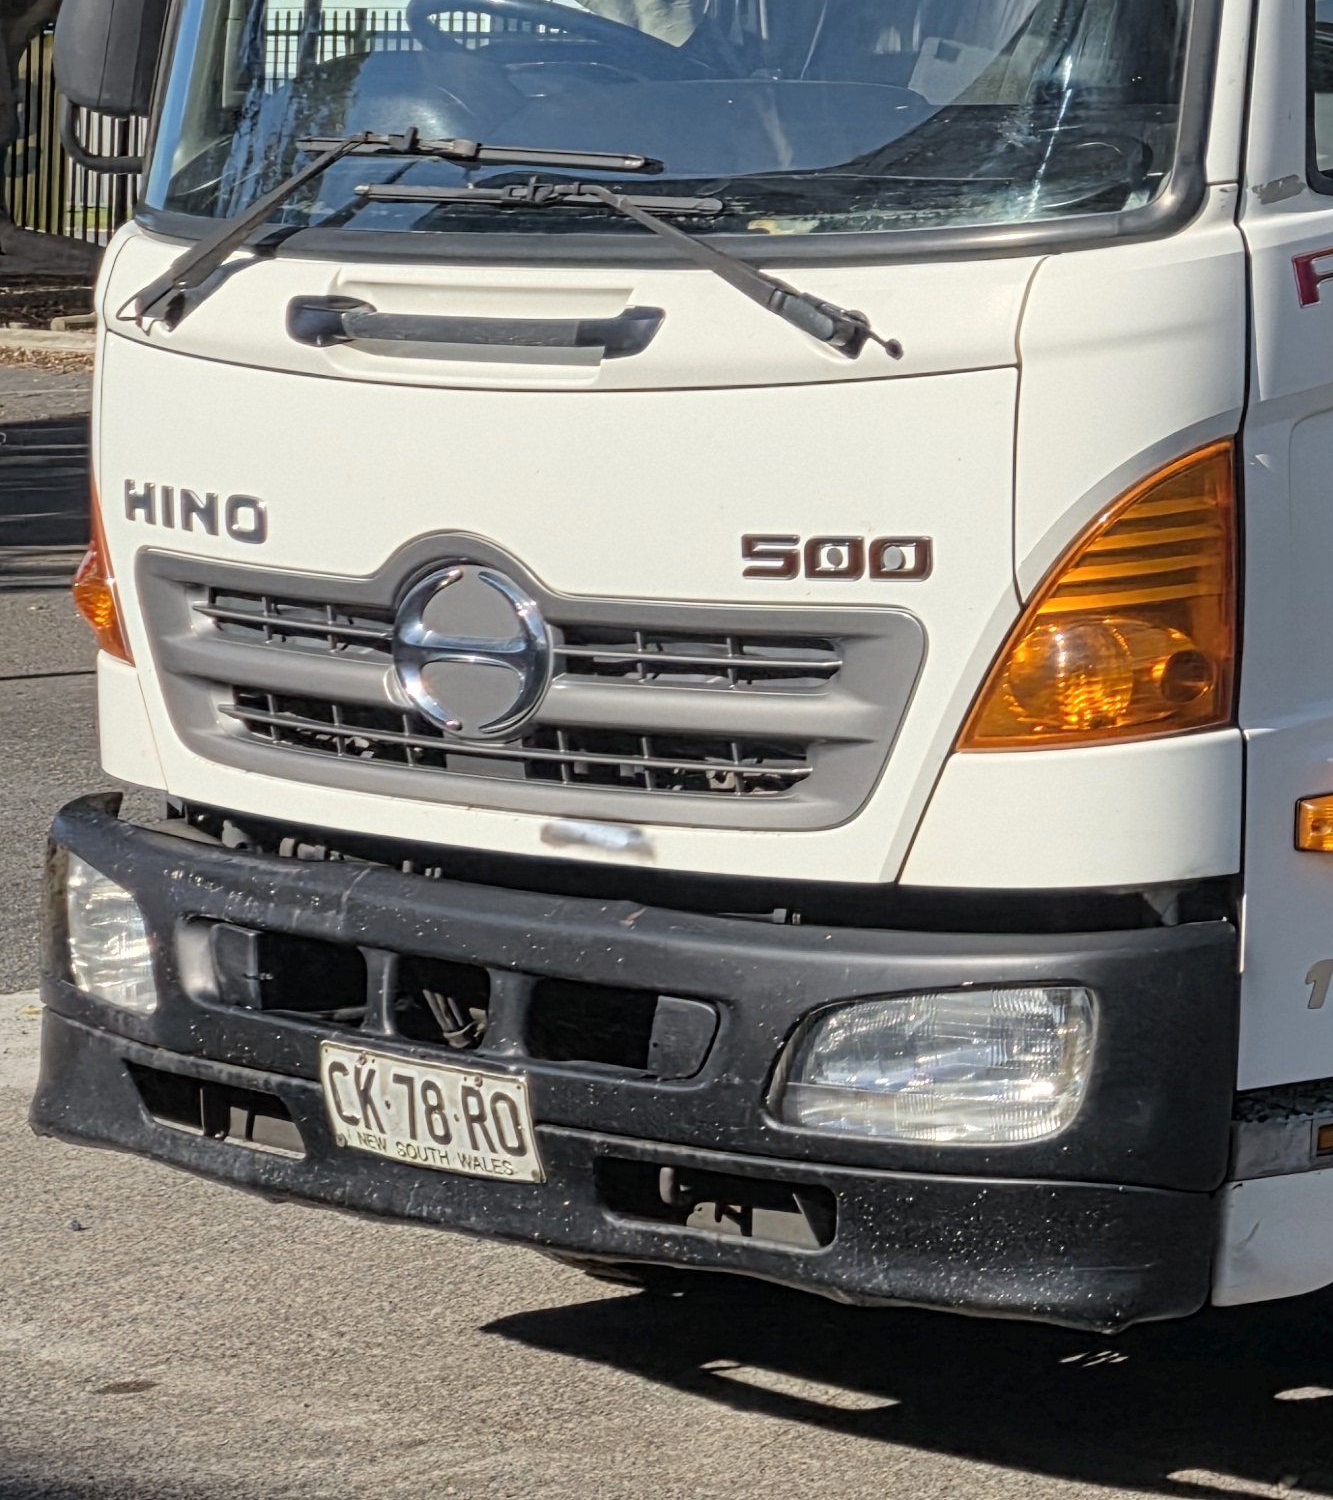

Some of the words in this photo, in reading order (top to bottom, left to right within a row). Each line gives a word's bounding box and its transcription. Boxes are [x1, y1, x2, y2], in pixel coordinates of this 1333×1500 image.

[124, 479, 268, 545] HINO
[741, 533, 934, 582] 500
[357, 1132, 387, 1151] NEW
[396, 1141, 450, 1166] SOUTH
[457, 1152, 515, 1176] WALES
